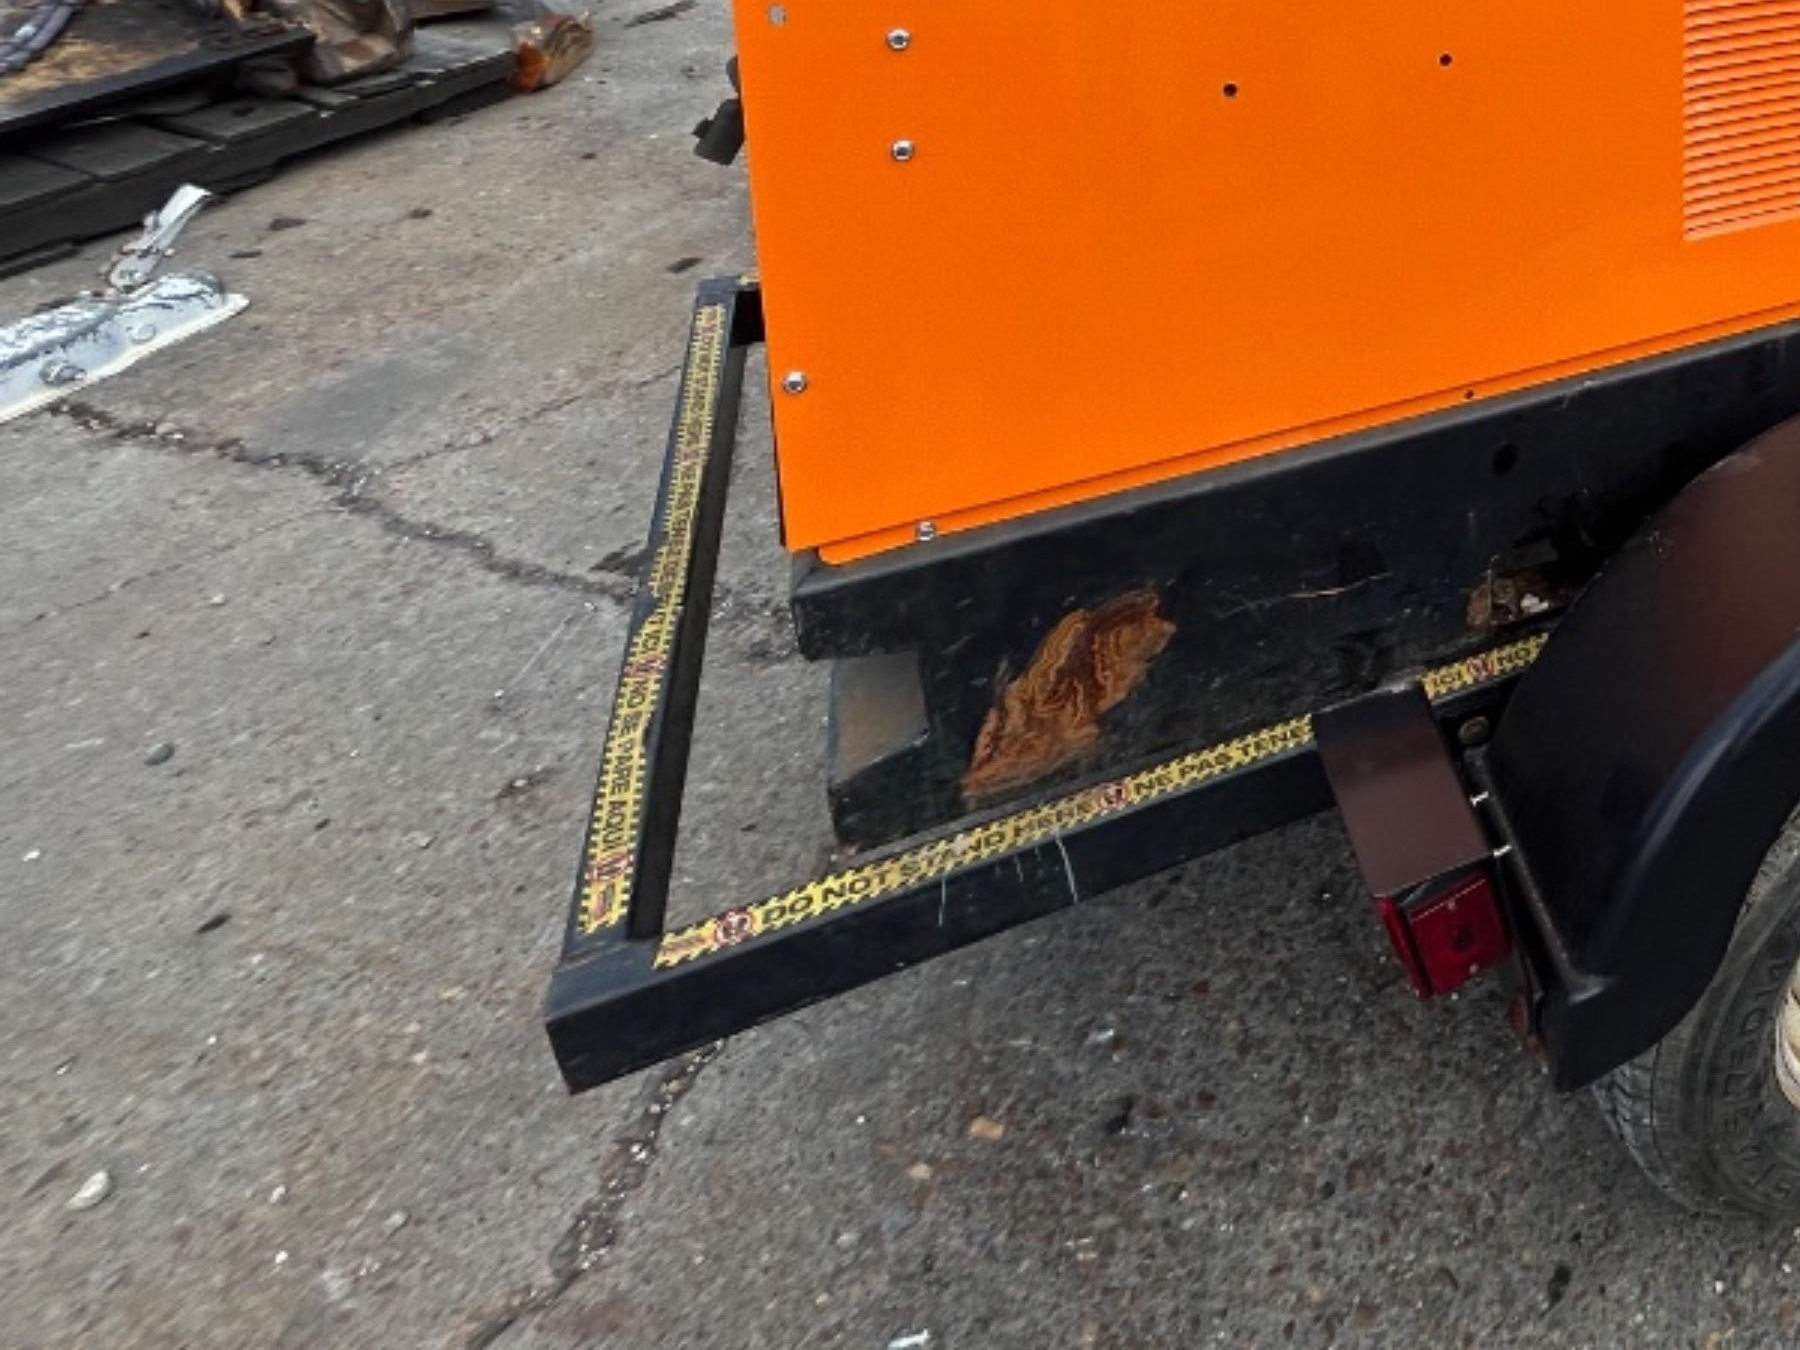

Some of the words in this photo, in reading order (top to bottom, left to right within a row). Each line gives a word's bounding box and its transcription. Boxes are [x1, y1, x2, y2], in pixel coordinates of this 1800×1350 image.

[1178, 749, 1233, 777] PAS
[761, 895, 813, 925] DO
[821, 870, 890, 903] NOT
[899, 831, 1007, 877] STAND
